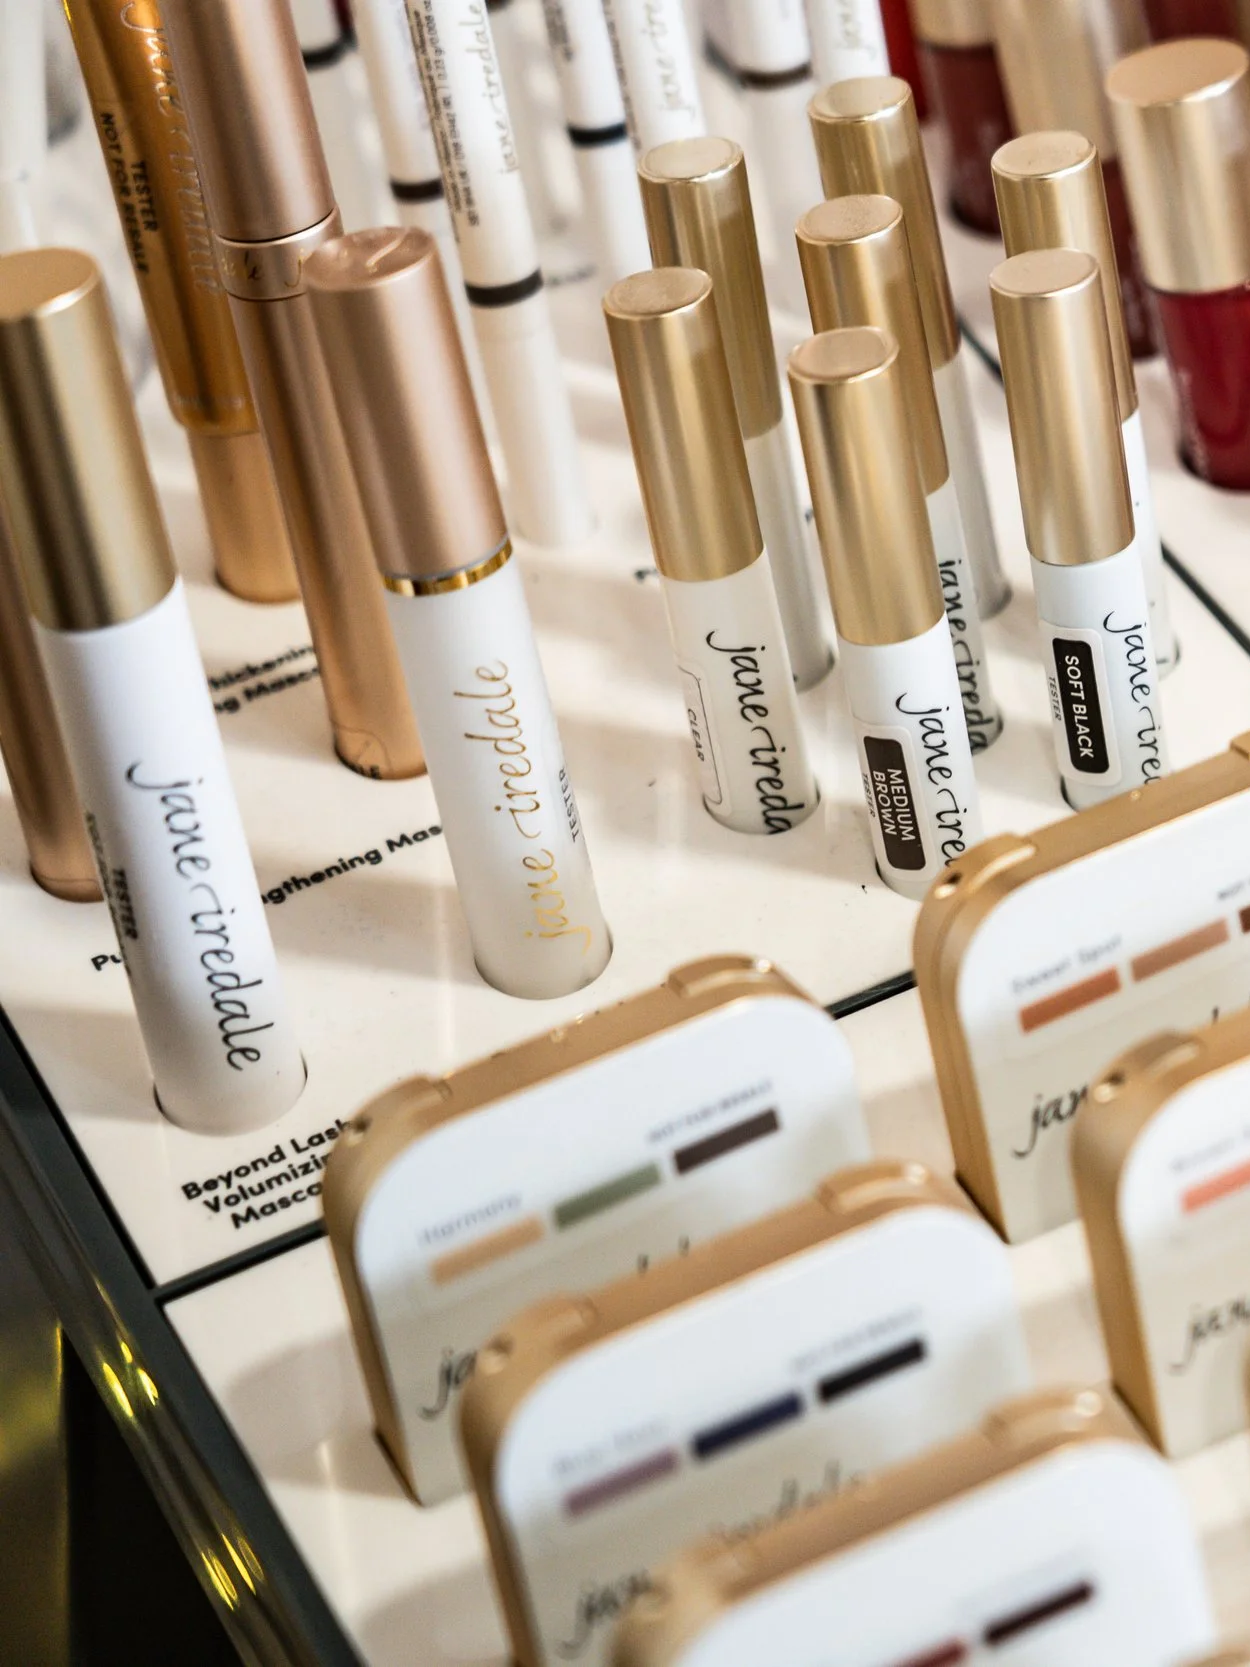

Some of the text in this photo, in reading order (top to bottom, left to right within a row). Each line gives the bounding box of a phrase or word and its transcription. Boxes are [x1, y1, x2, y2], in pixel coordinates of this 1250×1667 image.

[457, 2, 504, 117] iredale
[131, 160, 158, 232] TESTER
[705, 630, 768, 724] jane
[1102, 610, 1151, 704] jane
[686, 707, 706, 763] CLEAR
[1047, 675, 1063, 722] TESTER
[1064, 654, 1096, 759] SOFT BLACK
[453, 659, 593, 957] jane iredale
[557, 766, 586, 844] TESTER
[861, 772, 878, 819] TESTER
[871, 770, 899, 837] BROWN
[886, 767, 918, 843] MEDIUM
[894, 692, 969, 862] jane ire
[111, 867, 140, 942] TESTER
[125, 760, 275, 1073] jane iredale
[180, 1117, 351, 1201] Beyond Lash
